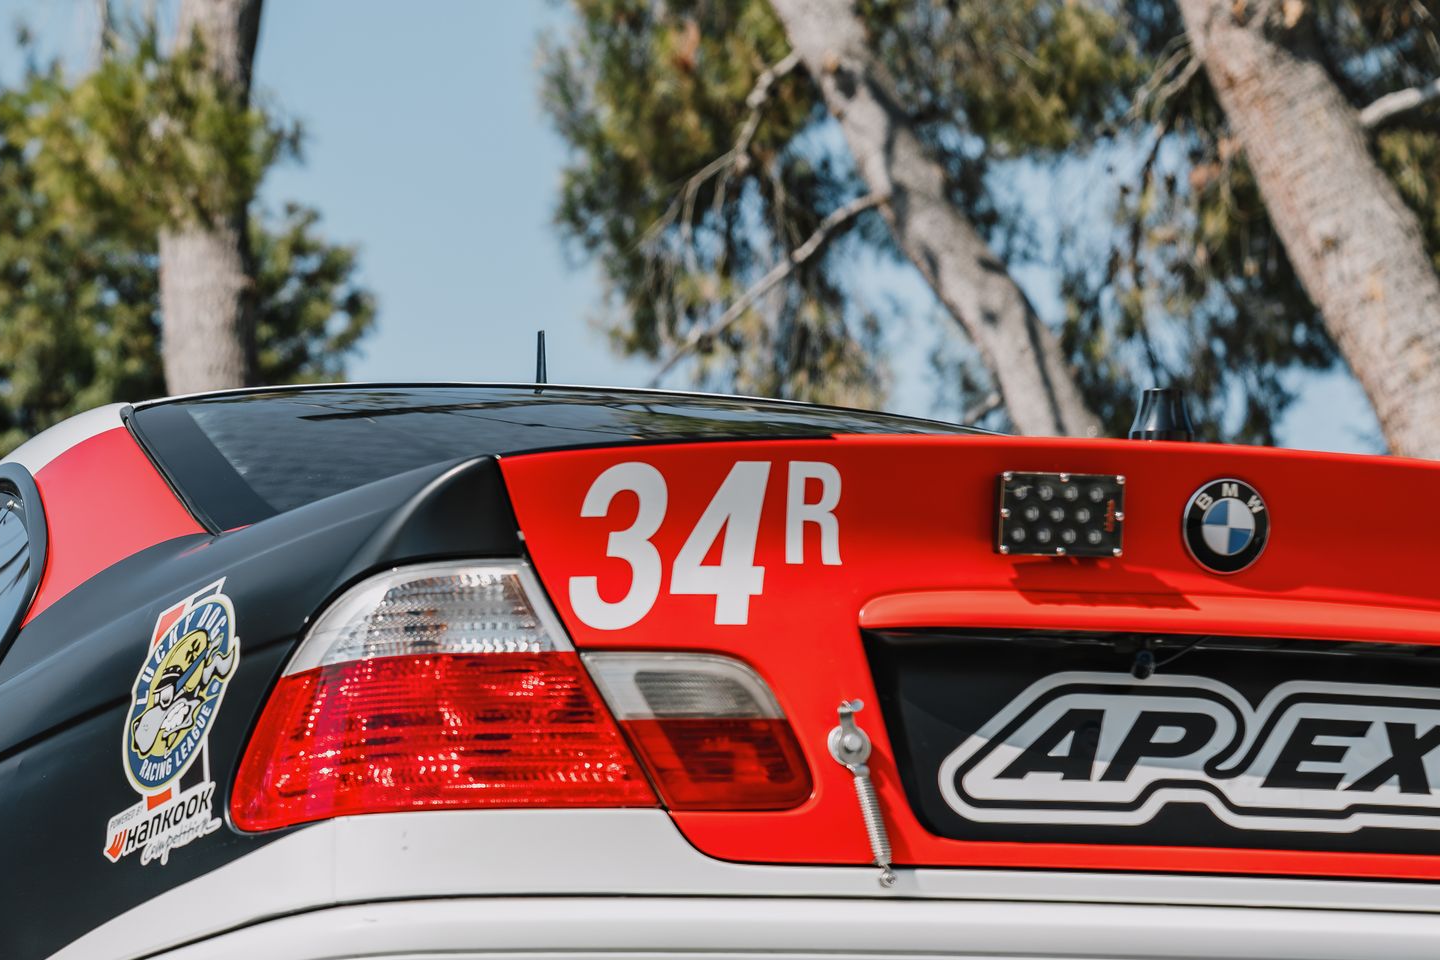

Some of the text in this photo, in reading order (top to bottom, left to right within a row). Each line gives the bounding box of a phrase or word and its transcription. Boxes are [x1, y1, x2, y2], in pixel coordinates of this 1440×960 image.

[1195, 482, 1265, 515] BMW
[136, 603, 227, 706] LUCKY DOG
[139, 705, 212, 782] RACING LEAGUE
[984, 700, 1440, 800] APEX
